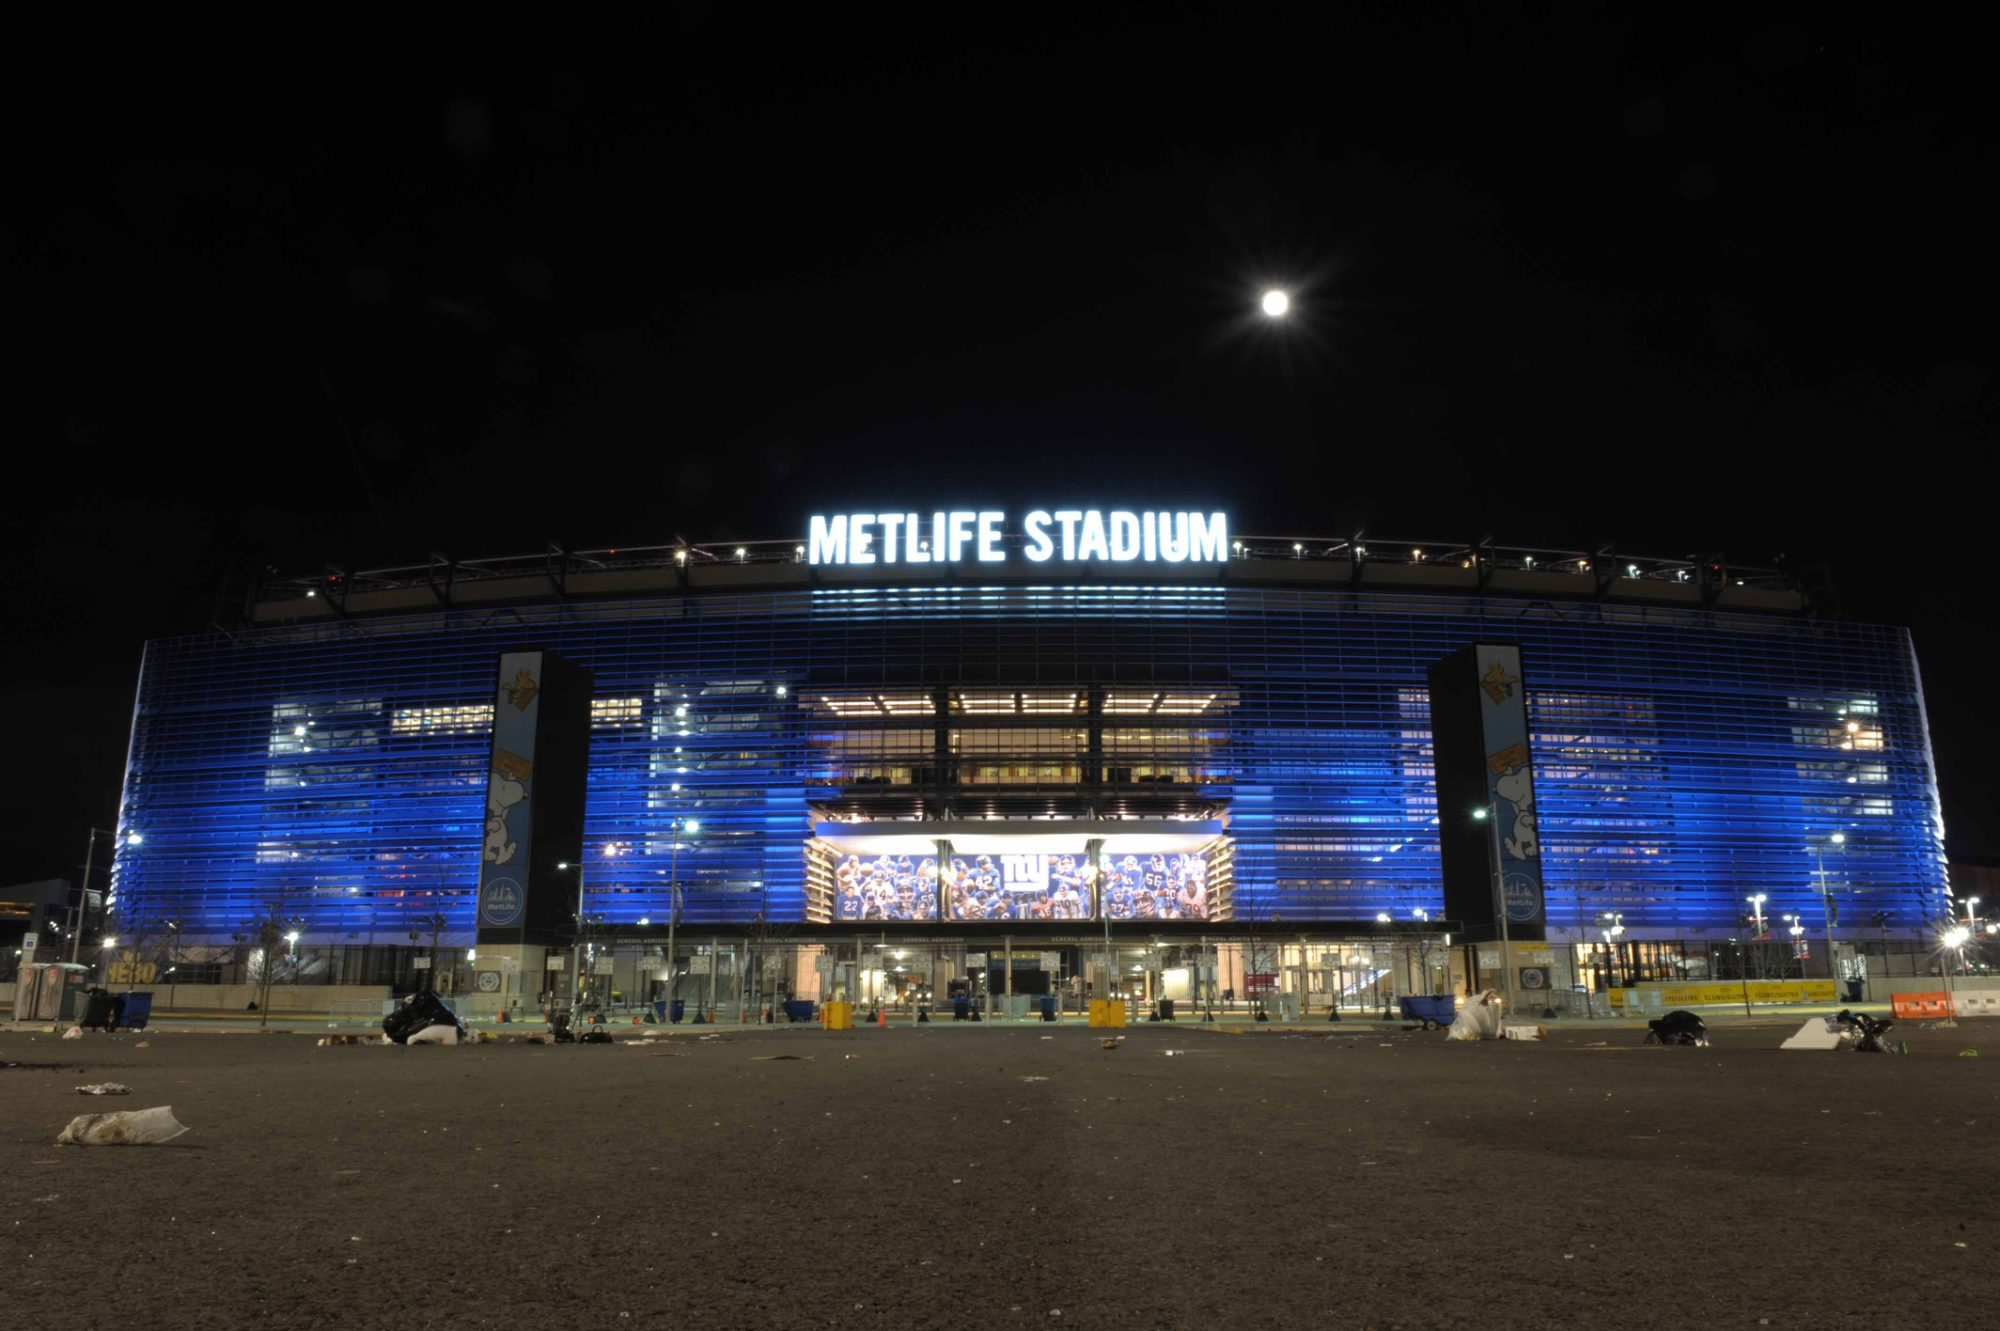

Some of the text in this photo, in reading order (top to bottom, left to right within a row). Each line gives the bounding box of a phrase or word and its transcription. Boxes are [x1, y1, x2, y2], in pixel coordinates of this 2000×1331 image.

[809, 510, 1228, 565] METLIFE STADIUM
[1146, 873, 1162, 886] 56
[874, 889, 887, 900] 14
[487, 902, 515, 911] MetLife
[844, 901, 858, 912] 22
[1754, 991, 1799, 999] CLUBS/SUITES
